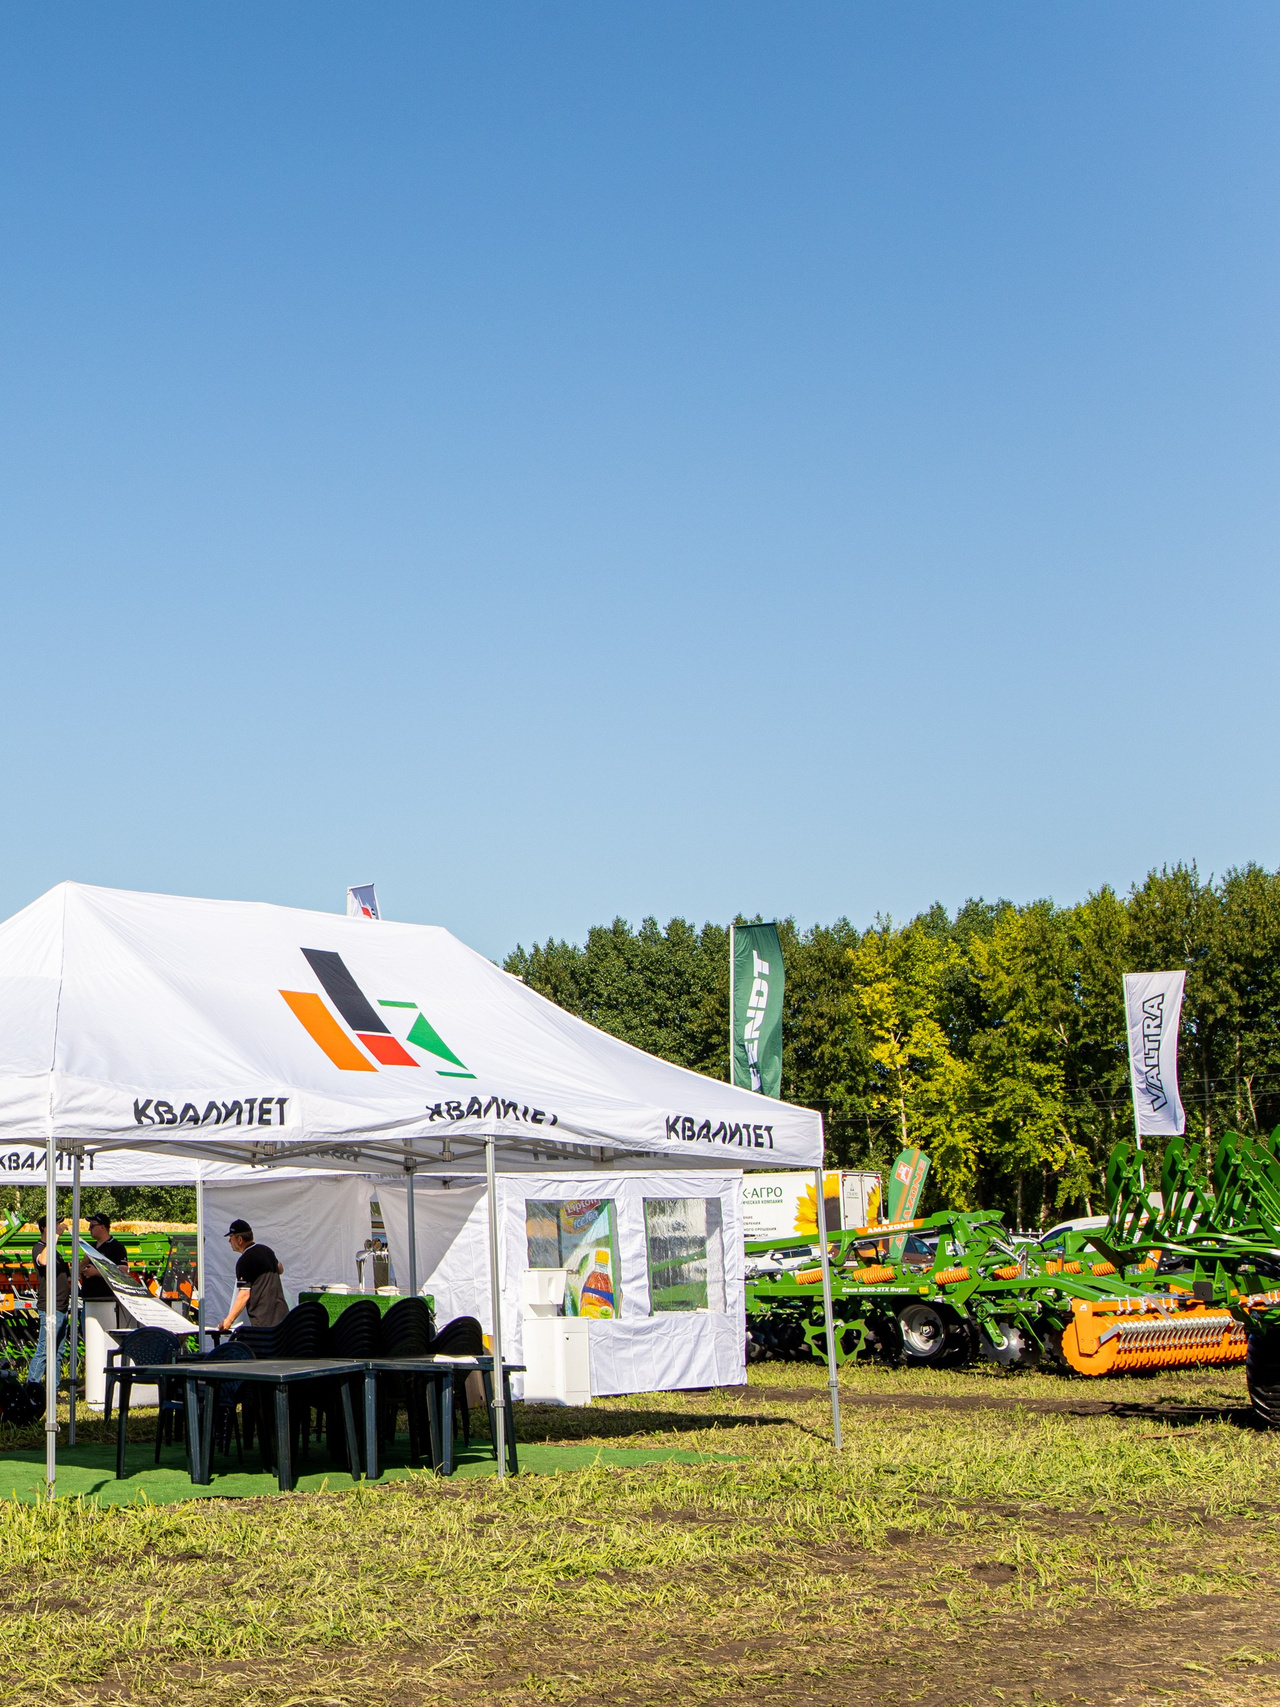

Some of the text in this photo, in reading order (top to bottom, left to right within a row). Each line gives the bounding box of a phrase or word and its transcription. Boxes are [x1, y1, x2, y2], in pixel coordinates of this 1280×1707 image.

[1142, 992, 1168, 1112] VALTRA
[133, 1097, 290, 1126] КВАЛИТЕТ
[665, 1115, 774, 1149] КВАЛИТЕТ
[866, 1221, 915, 1234] AMAZONE
